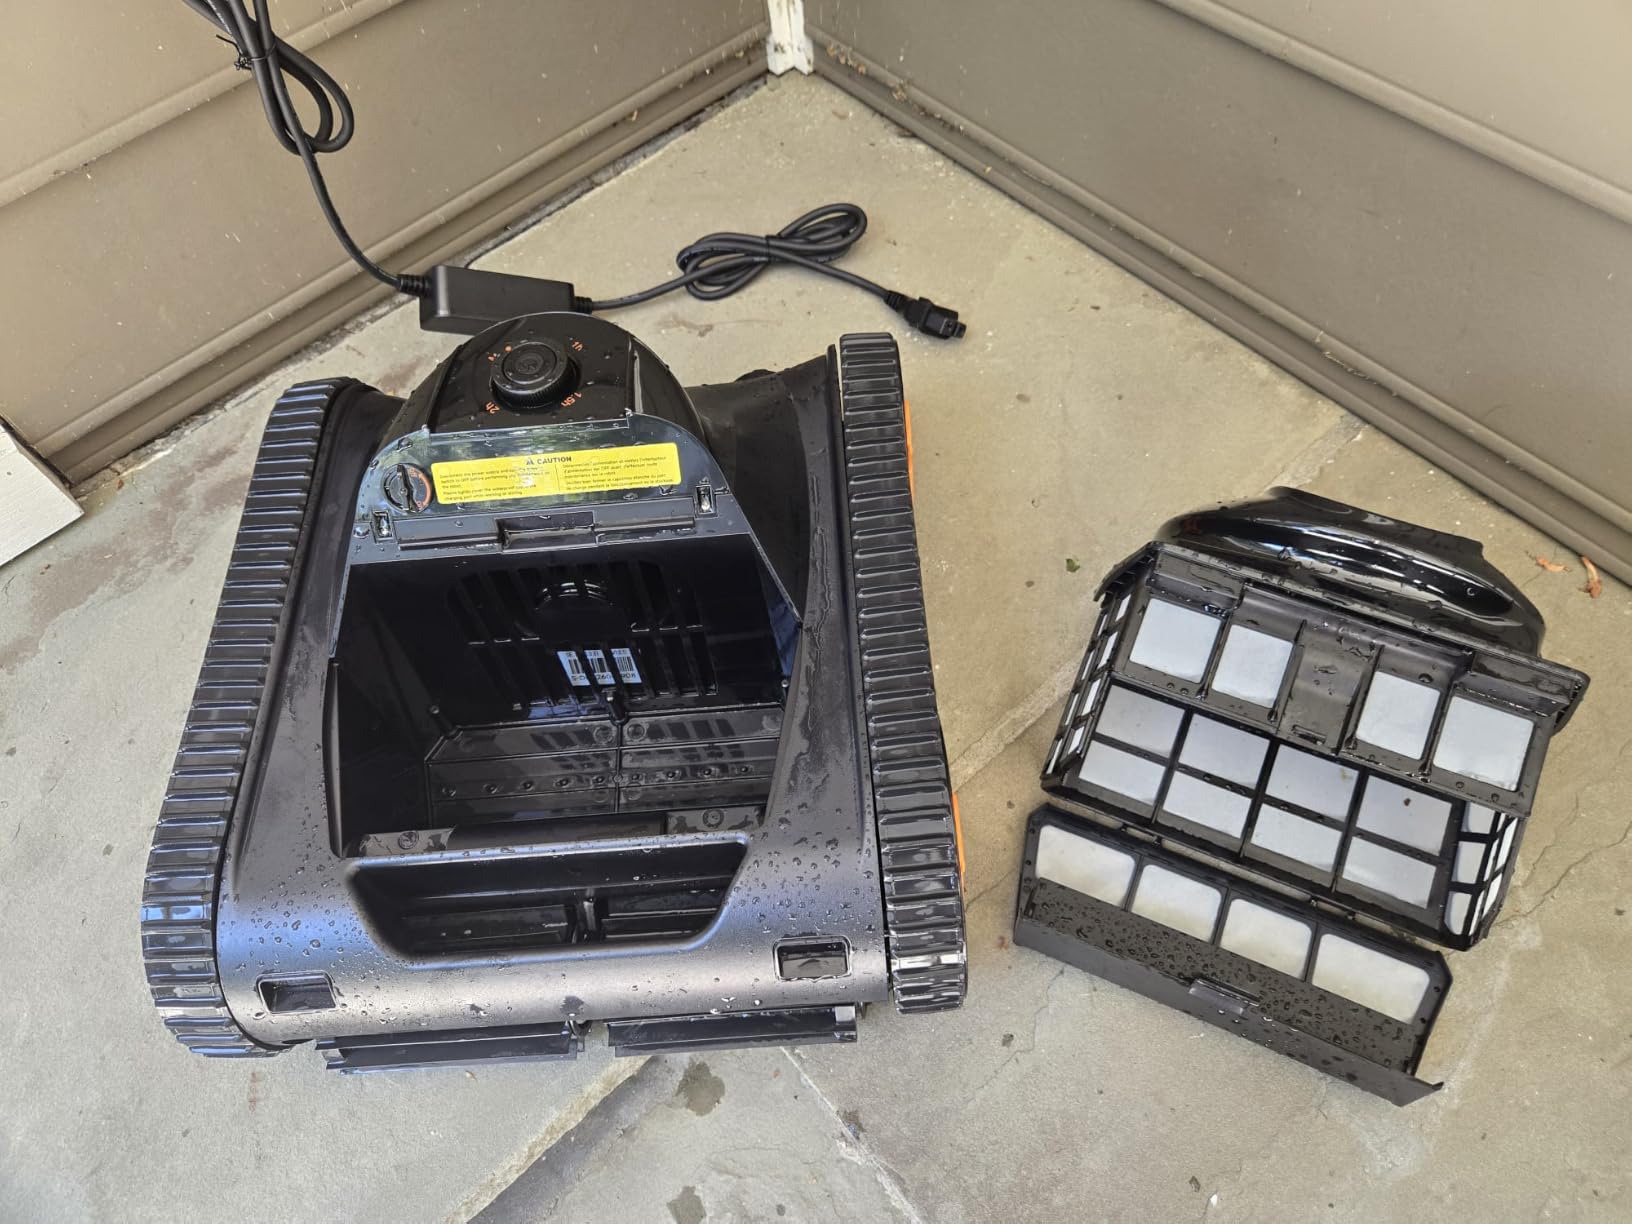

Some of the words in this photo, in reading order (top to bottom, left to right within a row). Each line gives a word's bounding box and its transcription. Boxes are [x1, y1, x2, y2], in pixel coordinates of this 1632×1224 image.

[571, 341, 583, 352] 1h
[486, 402, 500, 414] 2h
[537, 456, 572, 465] CAUTION
